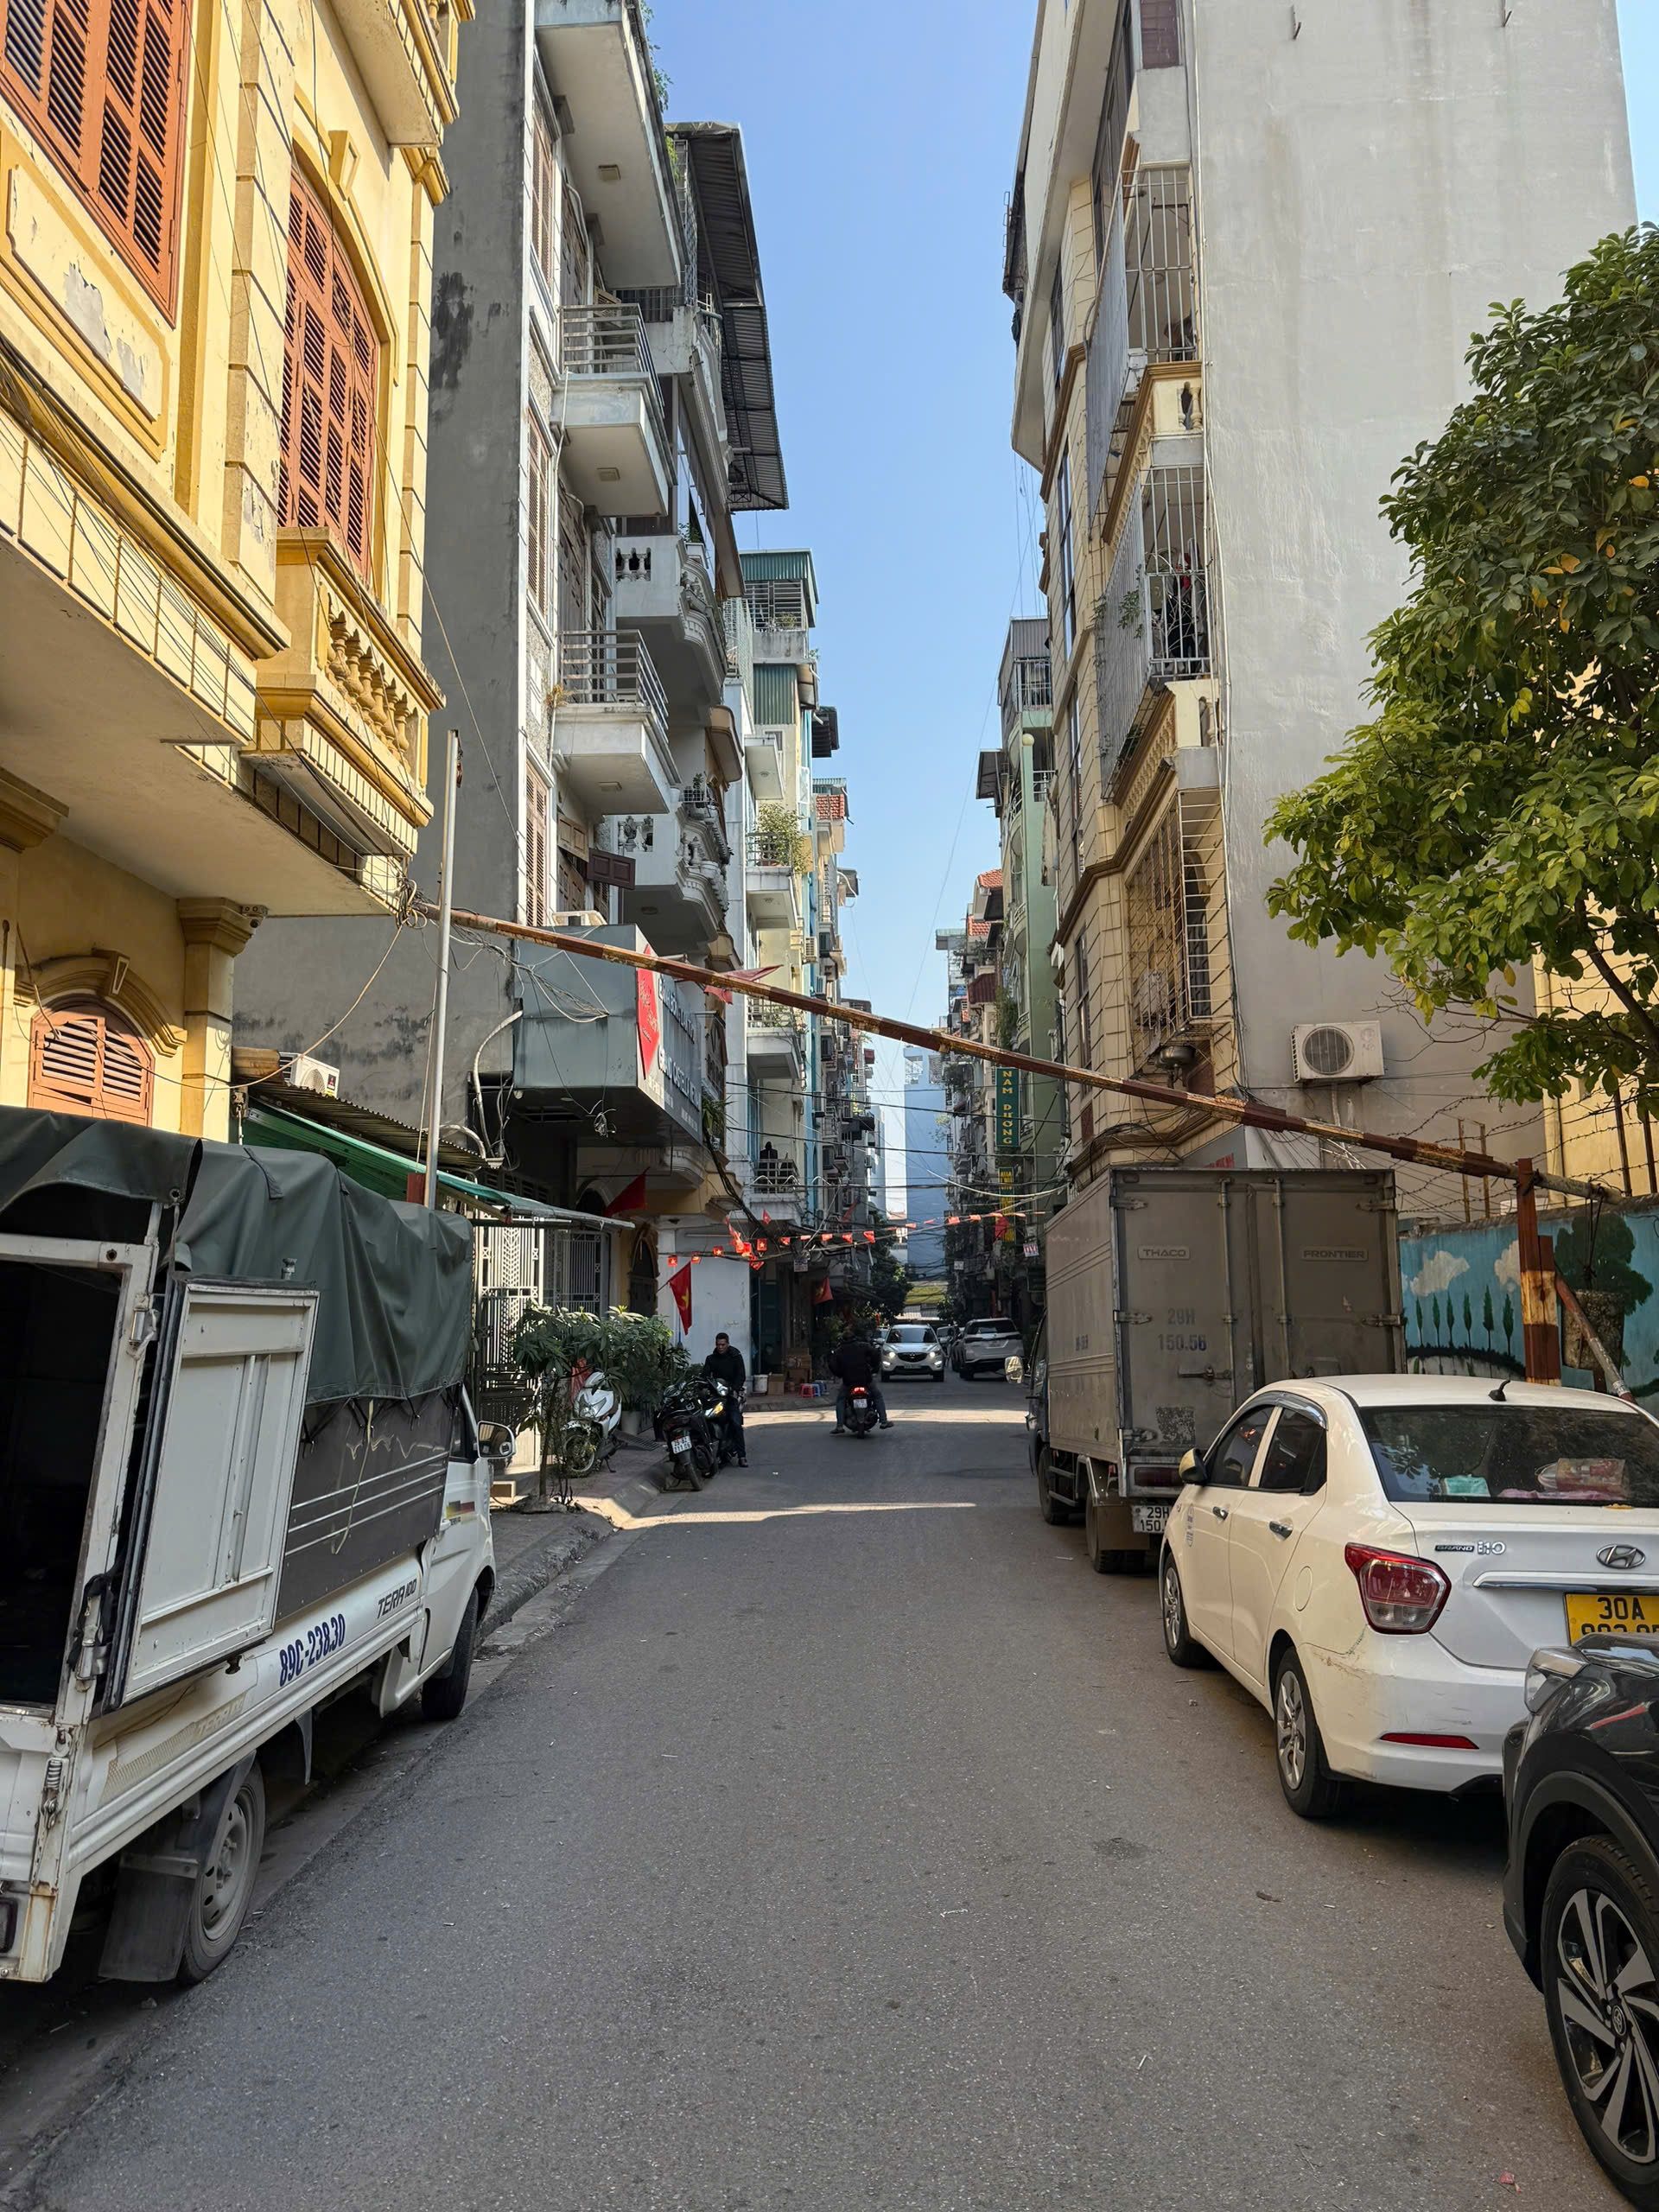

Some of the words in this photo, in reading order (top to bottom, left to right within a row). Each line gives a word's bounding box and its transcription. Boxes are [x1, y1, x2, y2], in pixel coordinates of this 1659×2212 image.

[1002, 1071, 1014, 1094] NAM
[1142, 1248, 1186, 1258] THACO
[1303, 1249, 1365, 1260] FRONTIER
[1158, 1333, 1207, 1352] 150.56
[1147, 1506, 1170, 1519] 29H
[1141, 1519, 1166, 1532] 150.
[1477, 1541, 1506, 1555] i10
[1597, 1597, 1645, 1620] 30A
[279, 1613, 346, 1688] 89C-238.30
